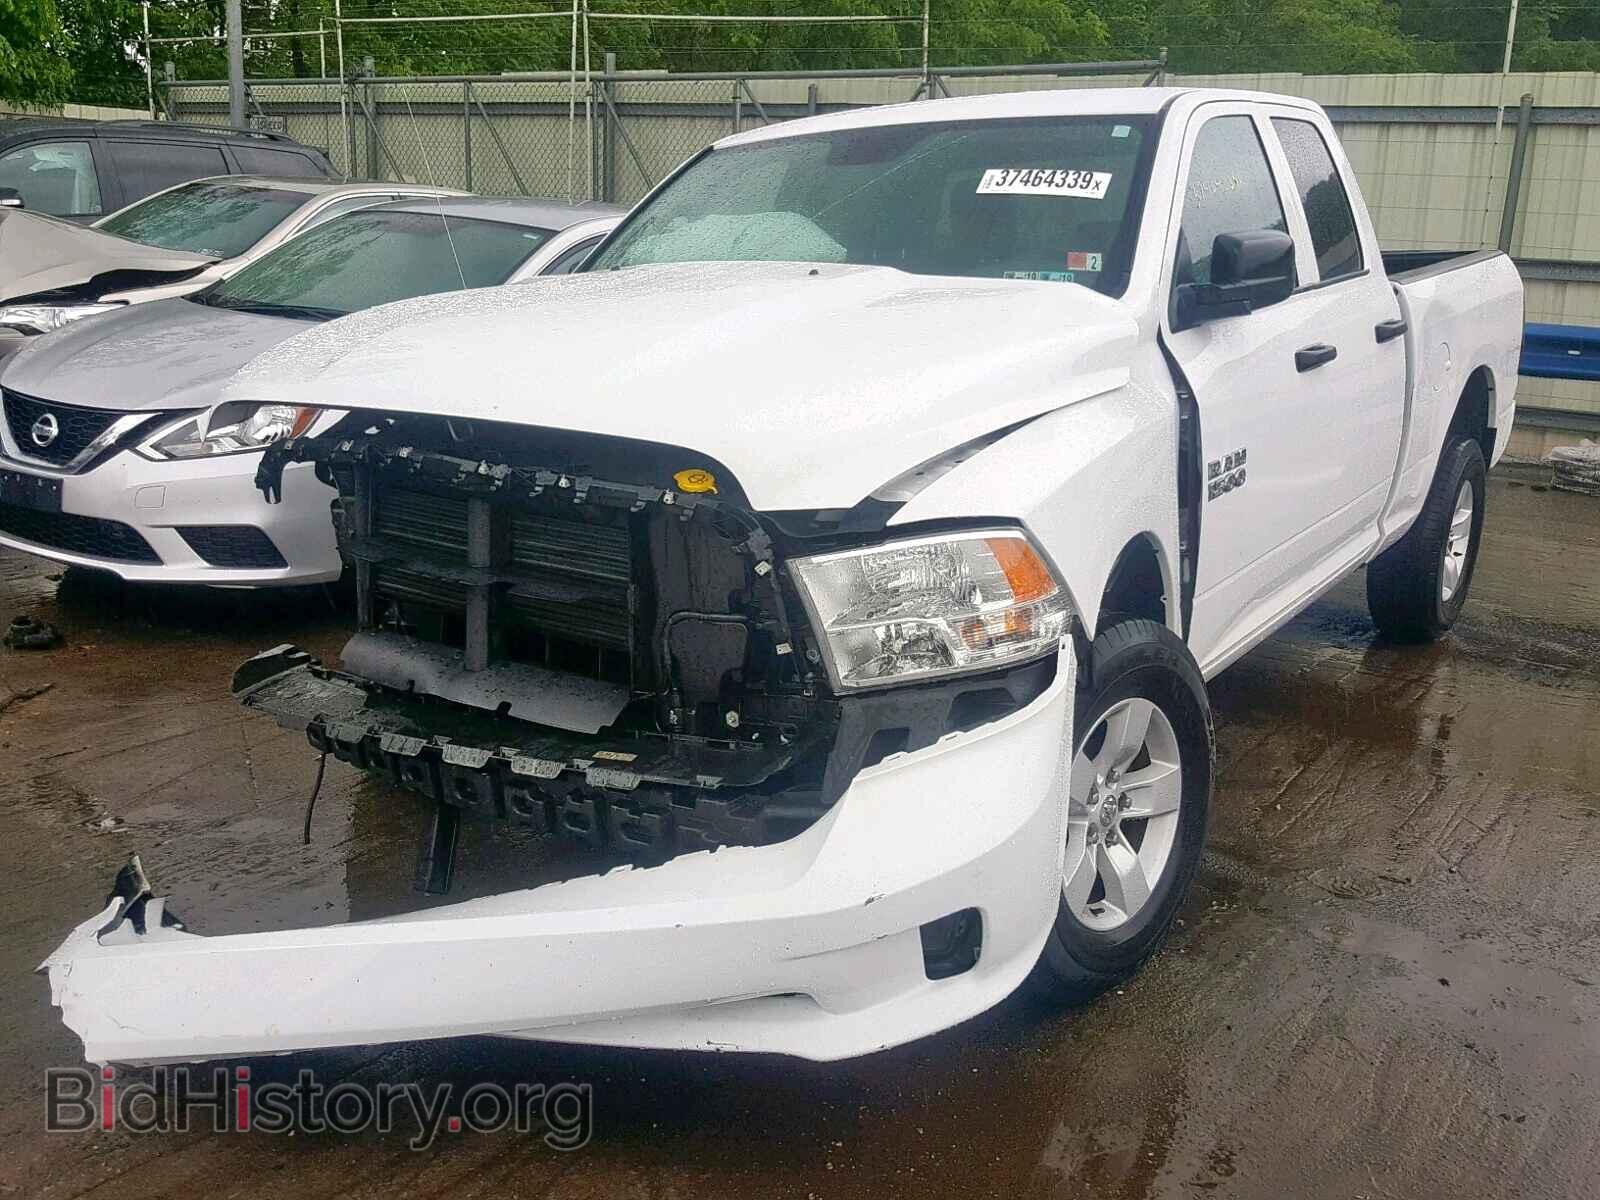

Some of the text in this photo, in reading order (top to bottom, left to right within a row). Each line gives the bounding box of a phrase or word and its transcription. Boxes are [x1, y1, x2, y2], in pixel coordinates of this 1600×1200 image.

[1090, 255, 1098, 271] 2
[1207, 448, 1247, 480] RAM
[1207, 467, 1247, 503] 1500
